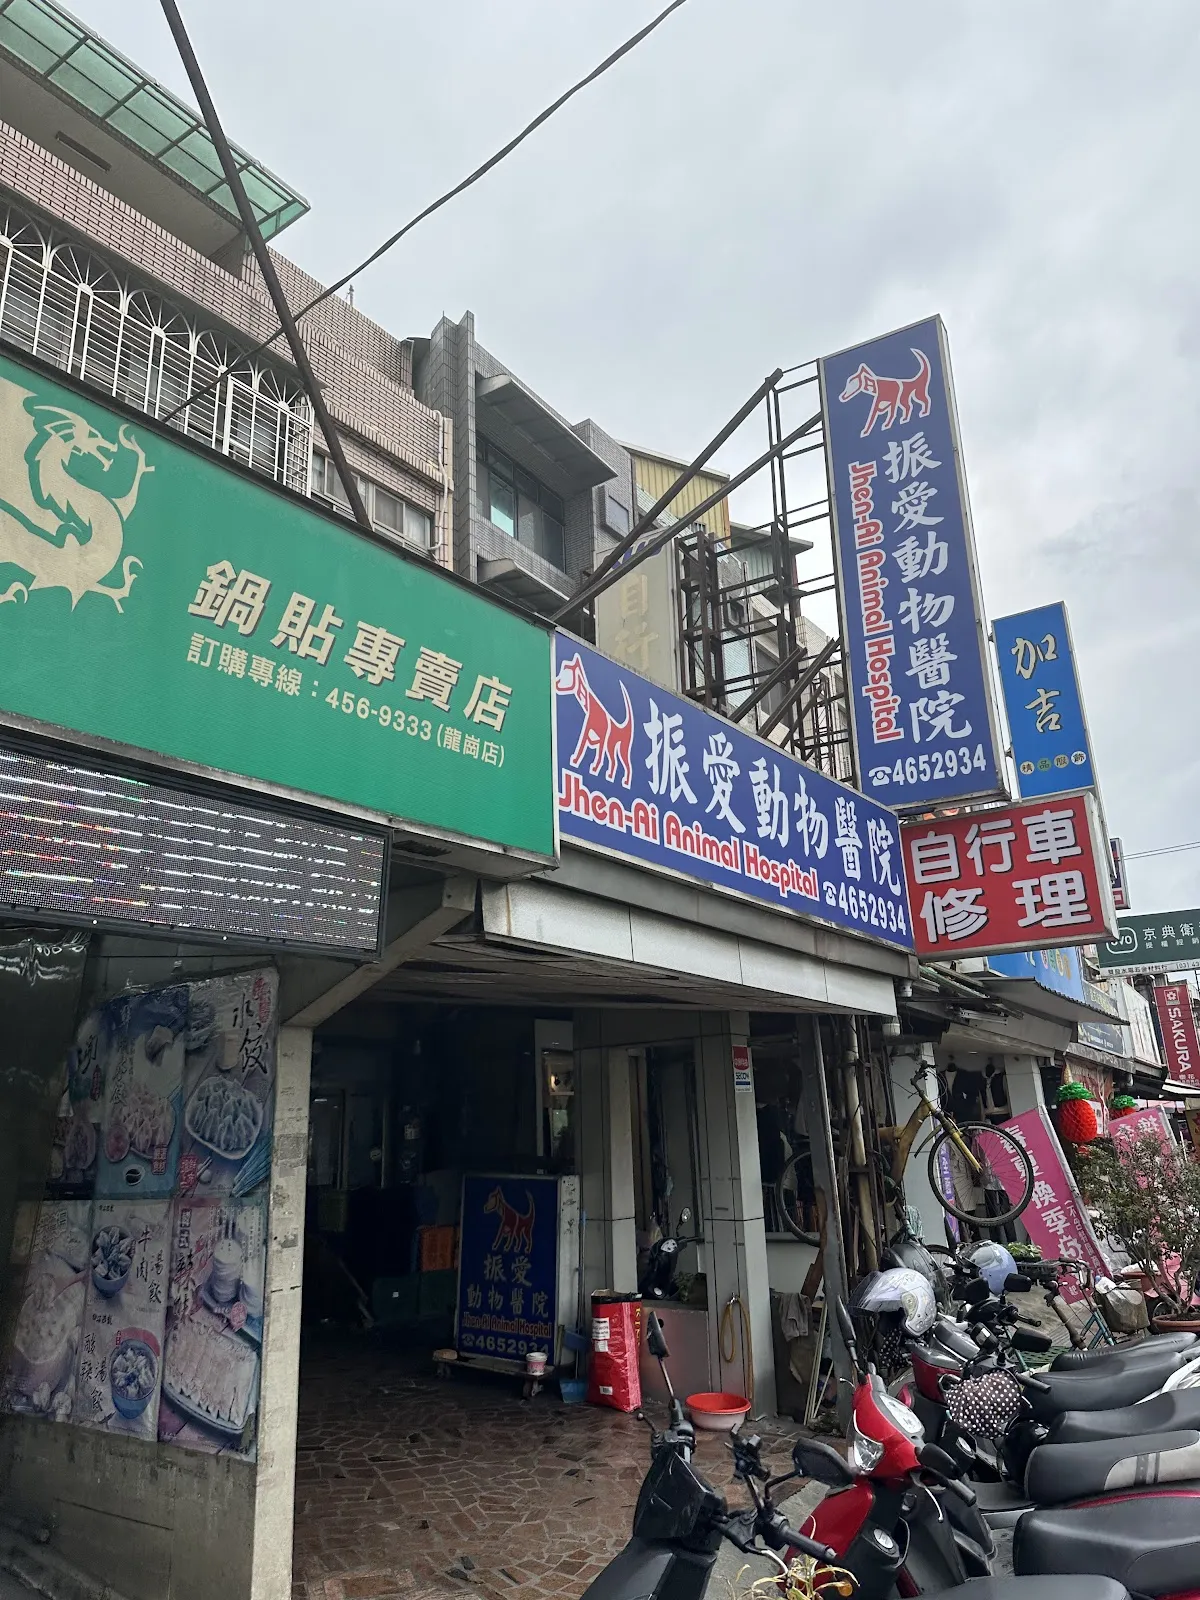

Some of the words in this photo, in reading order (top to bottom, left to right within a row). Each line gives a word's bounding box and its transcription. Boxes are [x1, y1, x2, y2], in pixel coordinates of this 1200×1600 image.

[849, 460, 885, 549] Jhen-Ai
[857, 549, 893, 635] Animal
[882, 431, 973, 743] 振愛動物醫院
[188, 559, 513, 732] 鍋貼專賣店
[863, 635, 904, 743] Hospital
[1011, 634, 1062, 733] 加吉
[643, 698, 901, 896] 振愛動物醫院
[893, 744, 987, 786] 4652934
[558, 769, 660, 845] Jhen-Ai
[664, 810, 741, 874] Animal
[743, 840, 819, 902] Hospital
[910, 809, 1082, 884] 自行車
[839, 882, 907, 935] 4652934
[920, 870, 1092, 942] 修理
[1142, 922, 1200, 940] 京典衛
[1168, 1007, 1192, 1073] SAKURA
[467, 1284, 549, 1318] 動物醫院
[483, 1253, 532, 1287] 振愛
[519, 1318, 552, 1339] Hospital
